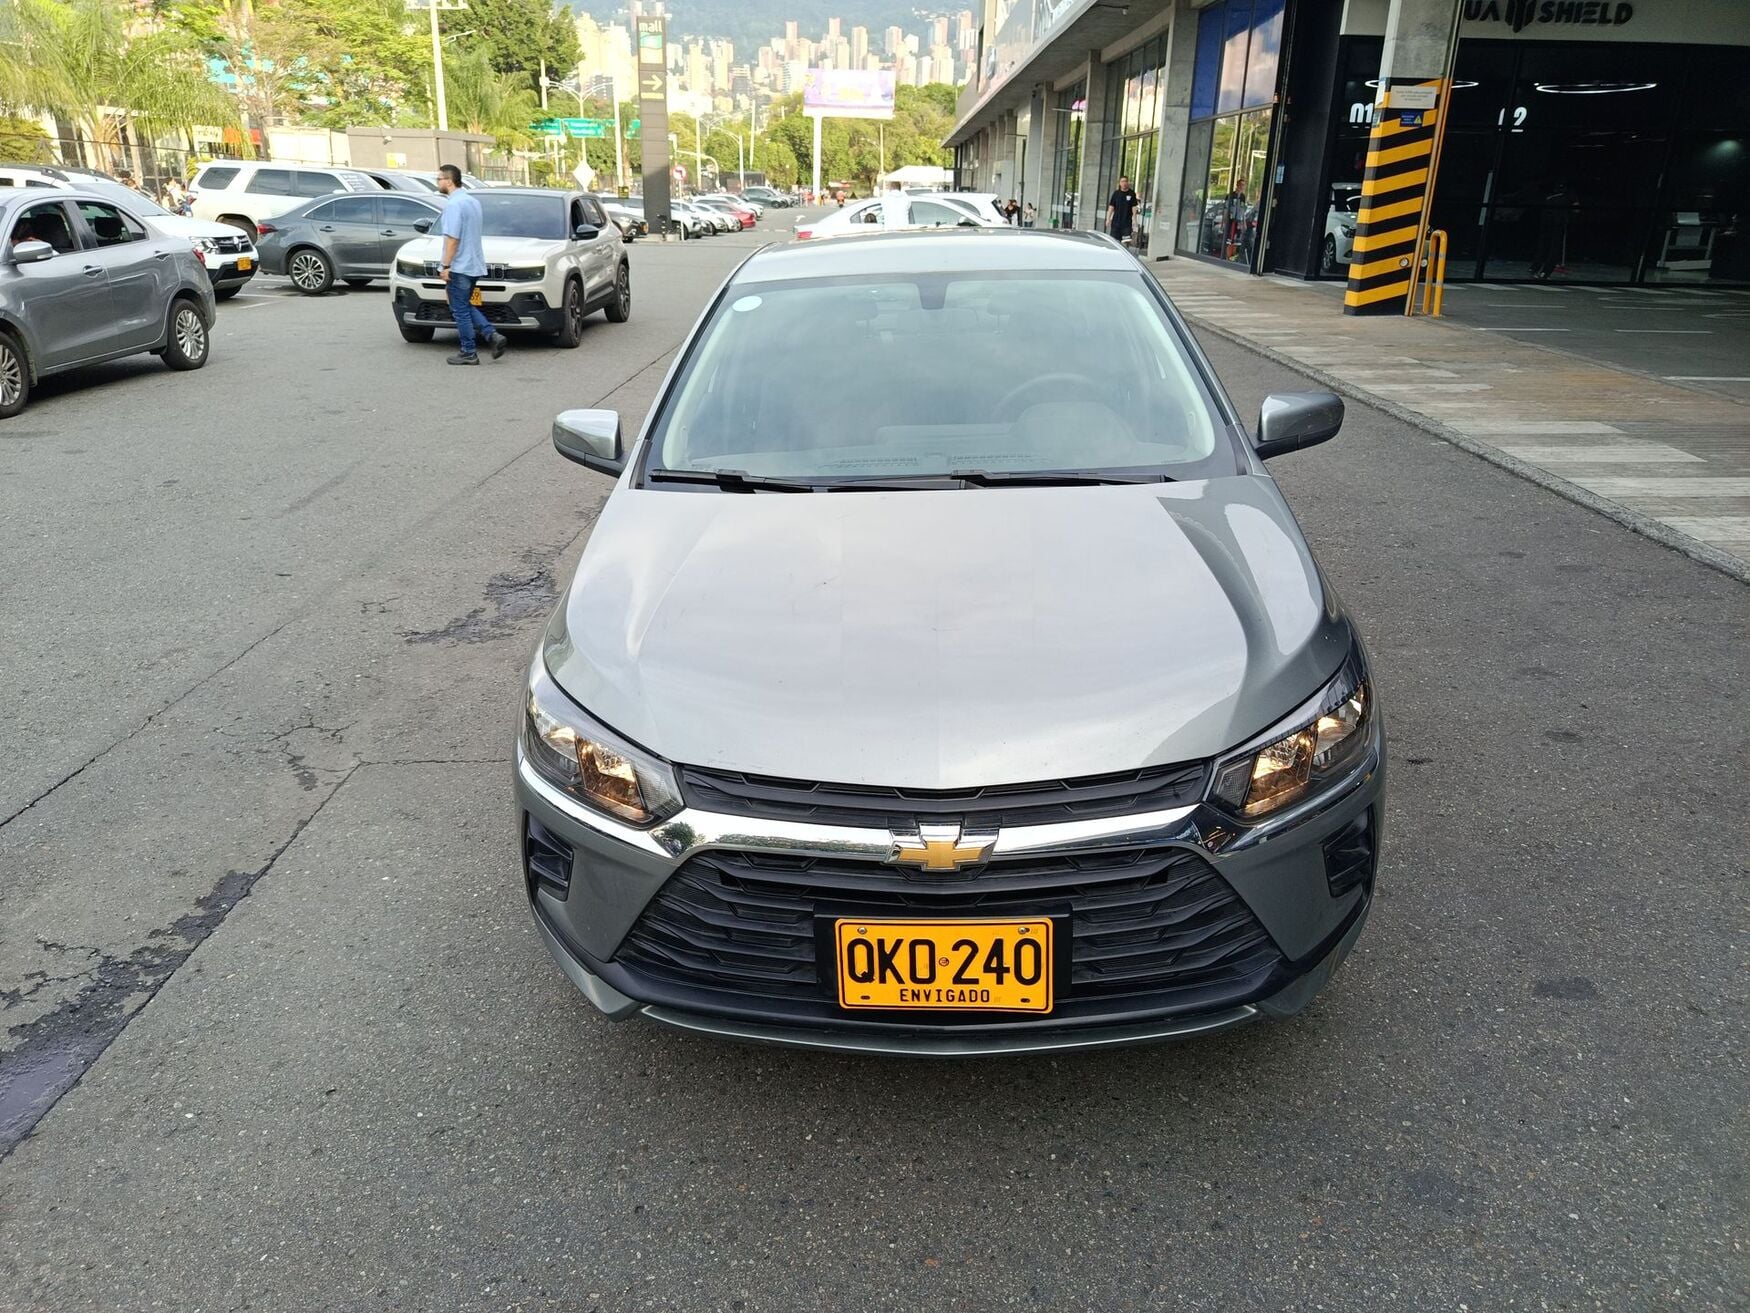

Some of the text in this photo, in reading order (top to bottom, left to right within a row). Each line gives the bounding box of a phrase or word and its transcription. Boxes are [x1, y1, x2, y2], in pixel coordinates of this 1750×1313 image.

[1463, 0, 1634, 25] UA SHIELD
[638, 20, 663, 32] mall
[847, 938, 1042, 986] QKO 240
[900, 988, 990, 1003] ENVIGADO
